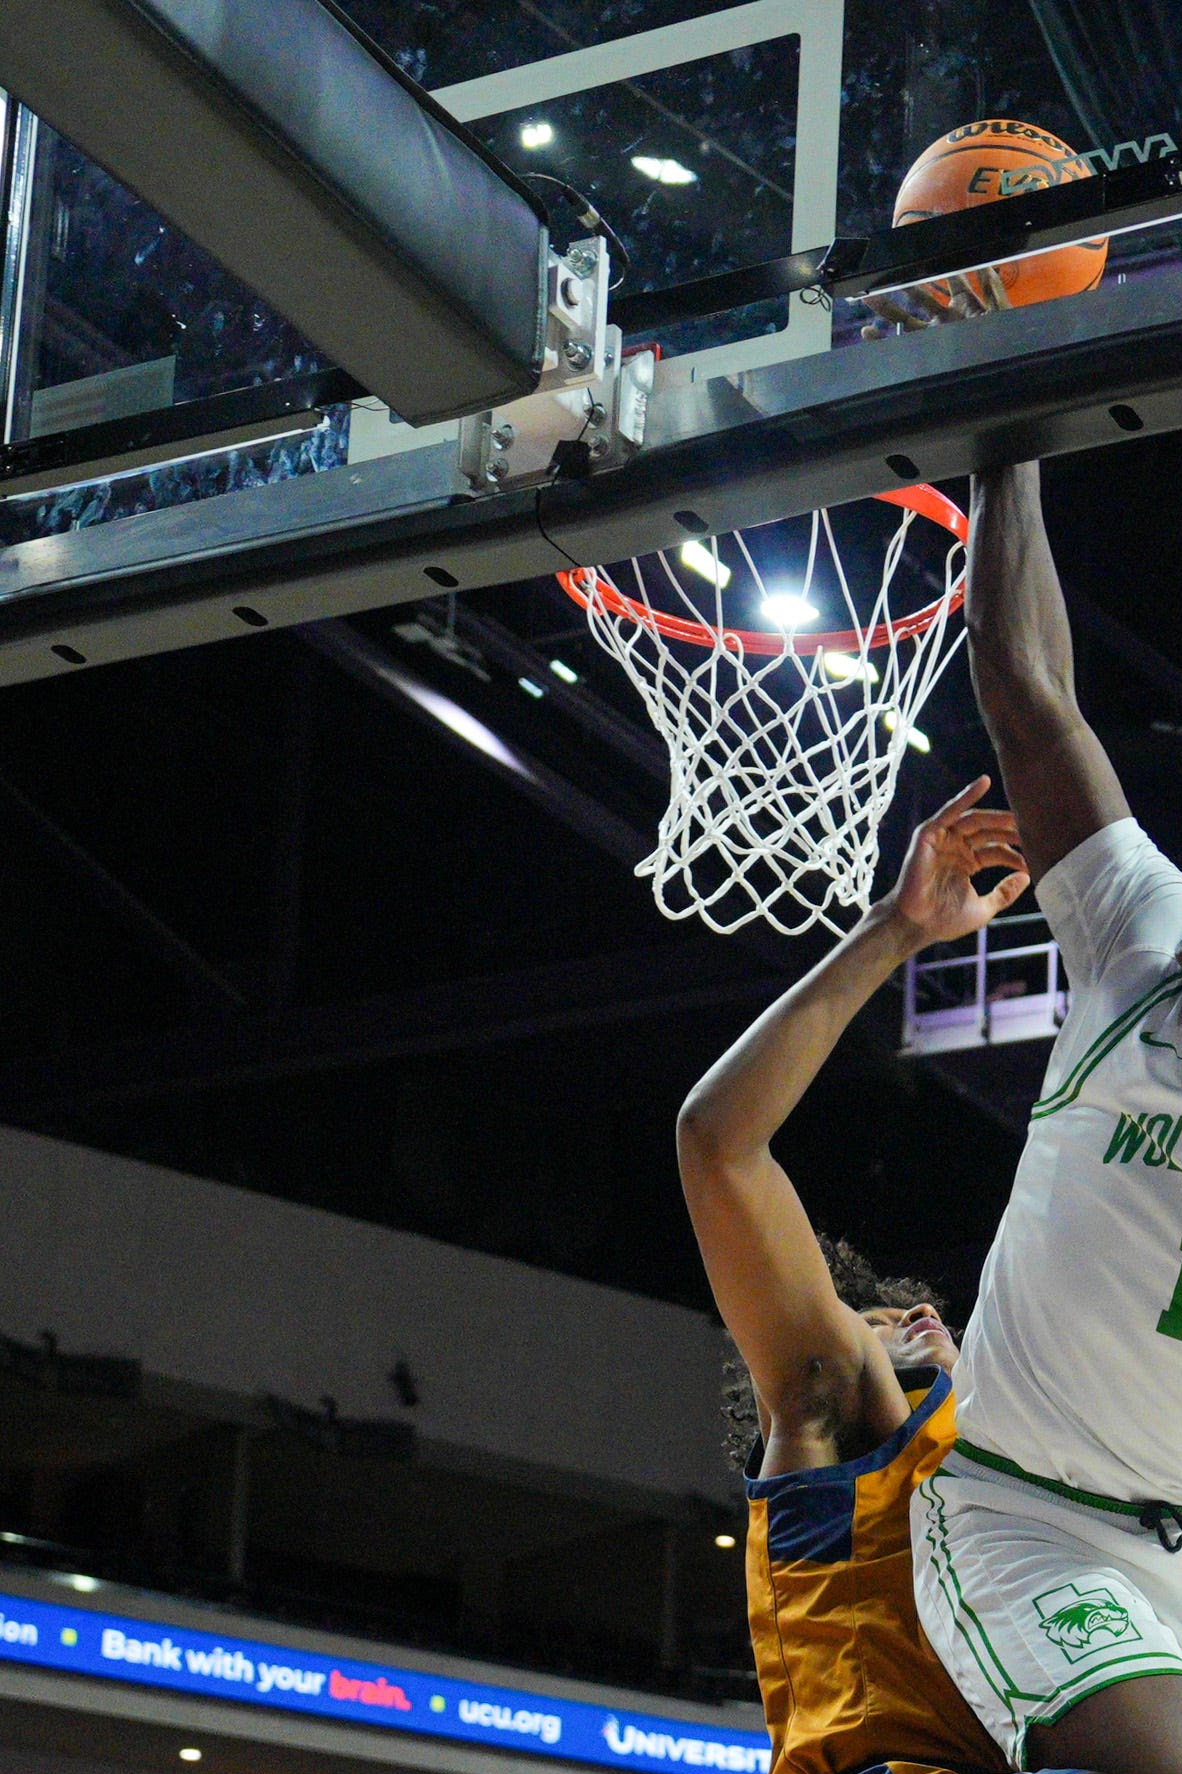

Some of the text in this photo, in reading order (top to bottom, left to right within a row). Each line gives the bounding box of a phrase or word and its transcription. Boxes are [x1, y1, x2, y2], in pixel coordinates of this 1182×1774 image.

[101, 1628, 182, 1671] Bank
[185, 1647, 254, 1684] with
[256, 1662, 326, 1696] your
[329, 1669, 411, 1711] brain.
[459, 1699, 562, 1744] ucu.org
